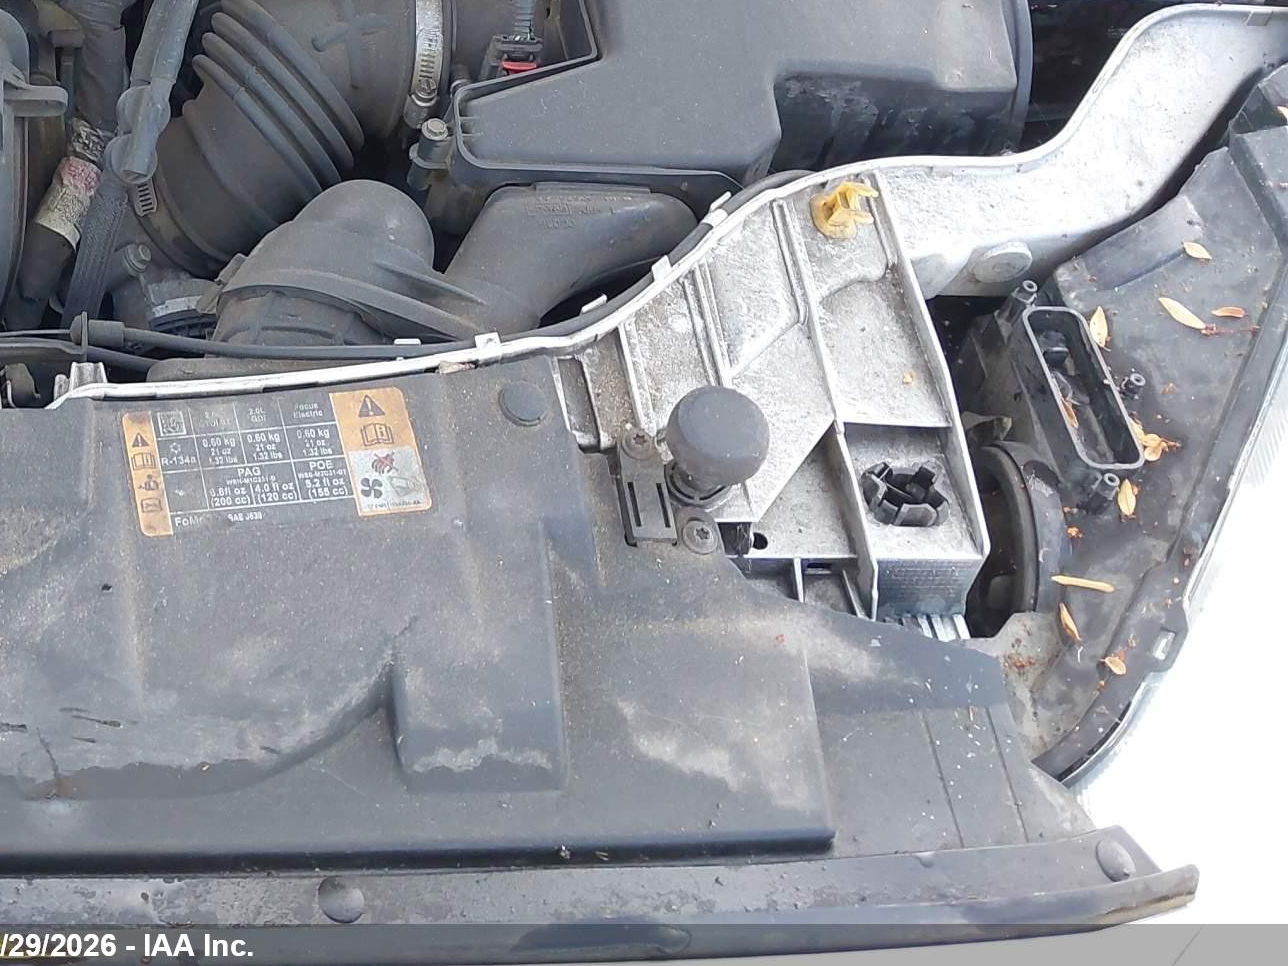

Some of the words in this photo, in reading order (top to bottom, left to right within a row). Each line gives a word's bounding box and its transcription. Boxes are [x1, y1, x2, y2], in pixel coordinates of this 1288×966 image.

[294, 402, 319, 411] Focus
[293, 409, 323, 419] Electric
[247, 432, 266, 443] 0.60
[267, 431, 281, 443] kg
[318, 427, 330, 439] kg
[202, 436, 221, 448] 0.60
[223, 435, 236, 448] kg
[255, 443, 264, 452] 21
[266, 442, 276, 450] oz
[305, 439, 314, 447] 21
[316, 438, 326, 446] oz
[210, 447, 220, 456] 21
[222, 446, 232, 455] oz
[253, 451, 269, 461] 1.32
[271, 450, 283, 459] lbs
[302, 447, 318, 457] 1.32
[320, 446, 333, 455] lbs
[161, 455, 197, 466] R-134a
[208, 455, 224, 465] 1.32
[225, 454, 238, 464] lbs
[309, 460, 333, 470] POE
[237, 466, 261, 477] PAG
[305, 478, 321, 488] 5.2
[323, 476, 331, 487] fl
[332, 478, 345, 486] oz
[234, 487, 247, 495] oz
[255, 483, 270, 494] 4.0
[272, 482, 280, 492] fl
[282, 482, 295, 491] oz
[308, 487, 330, 499] (155
[332, 485, 349, 497] cc)
[211, 495, 233, 508] (200
[235, 494, 251, 506] cc)
[258, 492, 279, 506] (120
[282, 490, 298, 502] cc)
[227, 513, 244, 522] SAE
